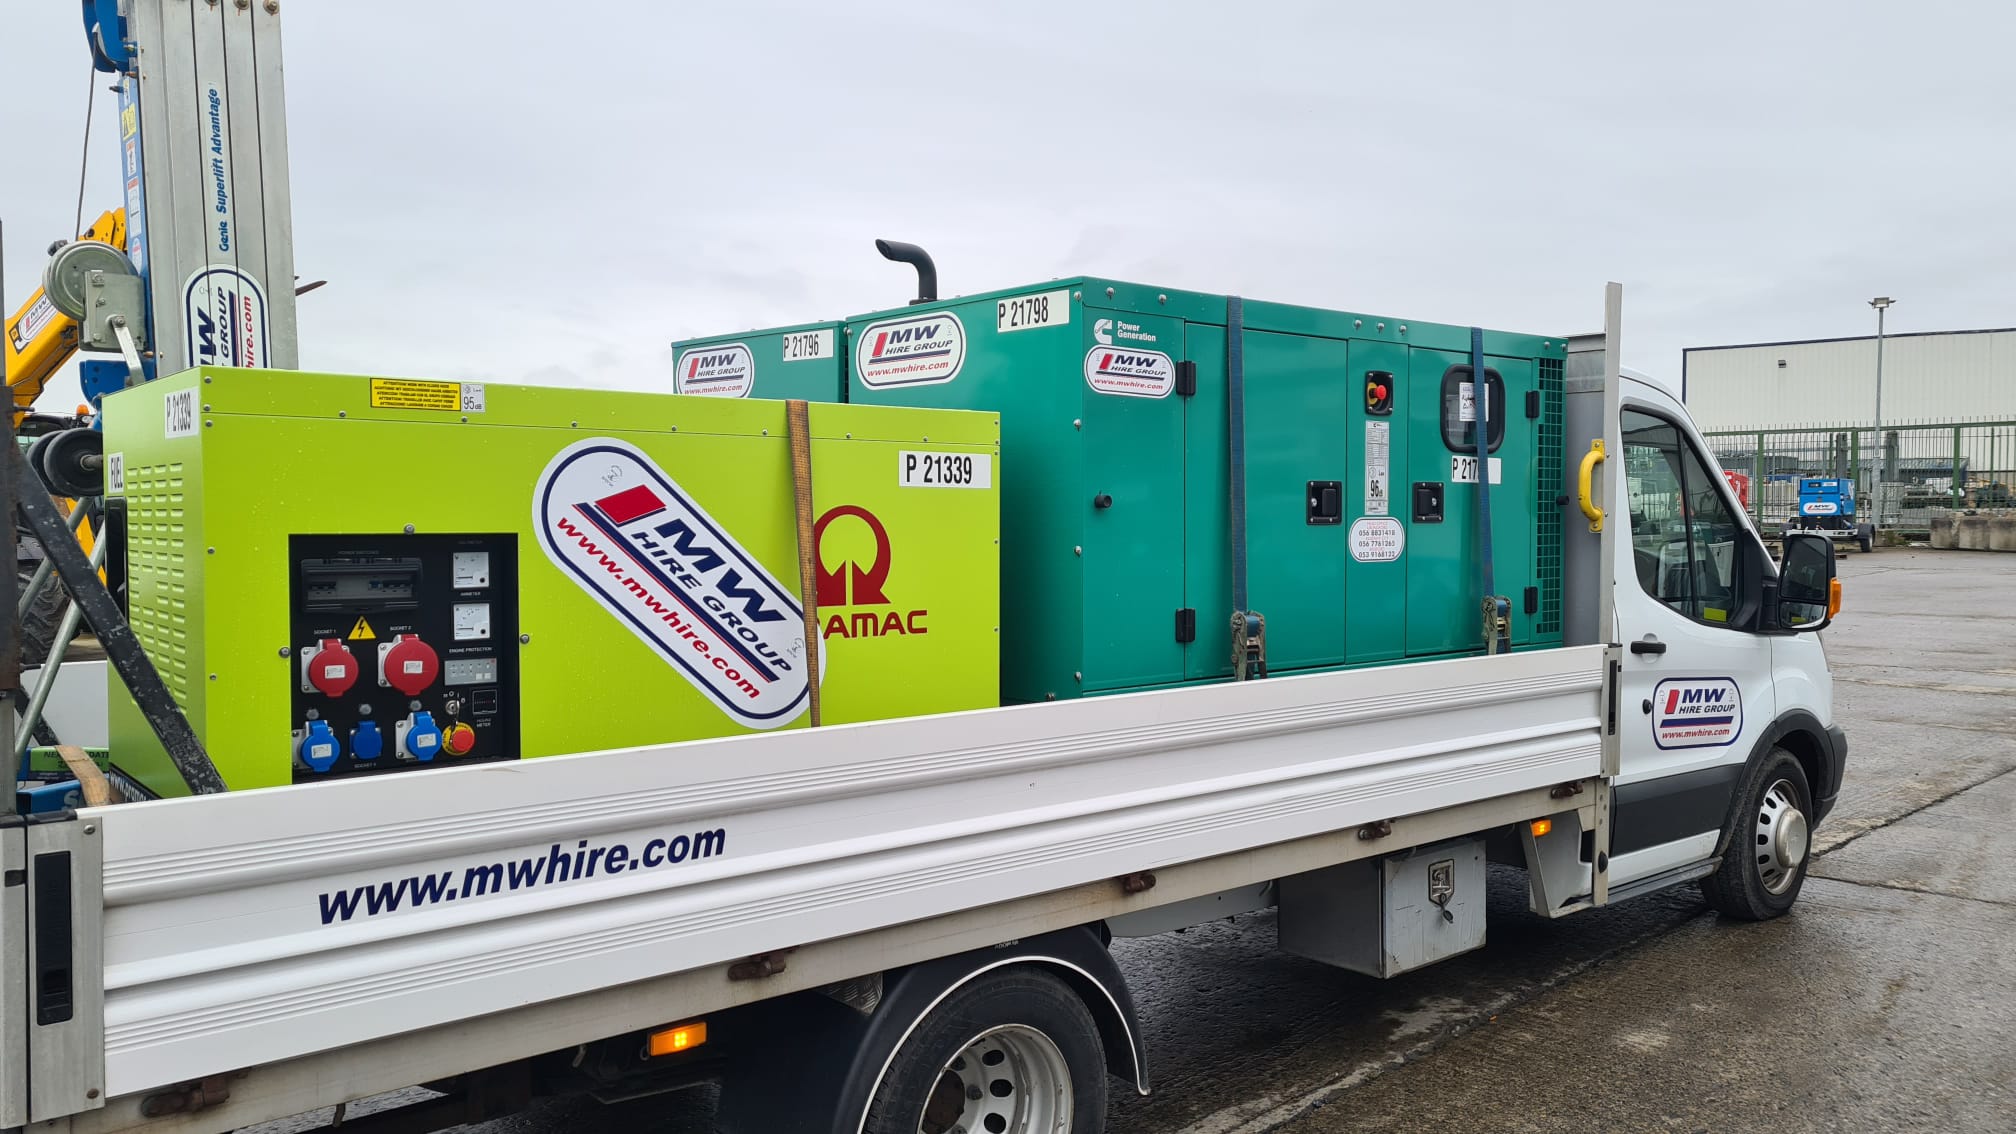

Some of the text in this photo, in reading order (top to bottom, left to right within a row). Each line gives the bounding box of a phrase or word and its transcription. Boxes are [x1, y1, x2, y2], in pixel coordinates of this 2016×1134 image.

[208, 88, 230, 252] Genie Superlift Advantage
[218, 286, 230, 358] GROUP
[998, 296, 1048, 329] P 21798
[197, 306, 217, 366] W
[244, 295, 255, 368] hire.com
[888, 323, 941, 345] MW
[1117, 320, 1156, 342] Power Generation
[784, 333, 819, 358] P 21796
[885, 340, 953, 355] HIRE GROUP
[697, 367, 745, 377] HIRE GROUP
[700, 353, 736, 368] MW
[867, 361, 949, 377] www.mwhire.com
[1114, 354, 1158, 368] MW
[1135, 368, 1166, 376] GROUP
[685, 384, 743, 395] www.mwhire.com
[1094, 378, 1163, 390] www.mwhire.com
[166, 391, 191, 432] P 21339
[111, 457, 123, 488] FUEL
[906, 454, 972, 484] P 21339
[1452, 457, 1479, 480] P 217
[653, 518, 787, 623] MW
[557, 517, 760, 699] www.mwhire.com
[632, 532, 792, 672] HIRE GROUP
[817, 610, 928, 640] AMAC
[1682, 688, 1726, 704] MW
[1679, 704, 1735, 714] HIRE GROUP
[1662, 728, 1730, 739] www.mwhire.com
[318, 827, 726, 925] www.mwhire.com
